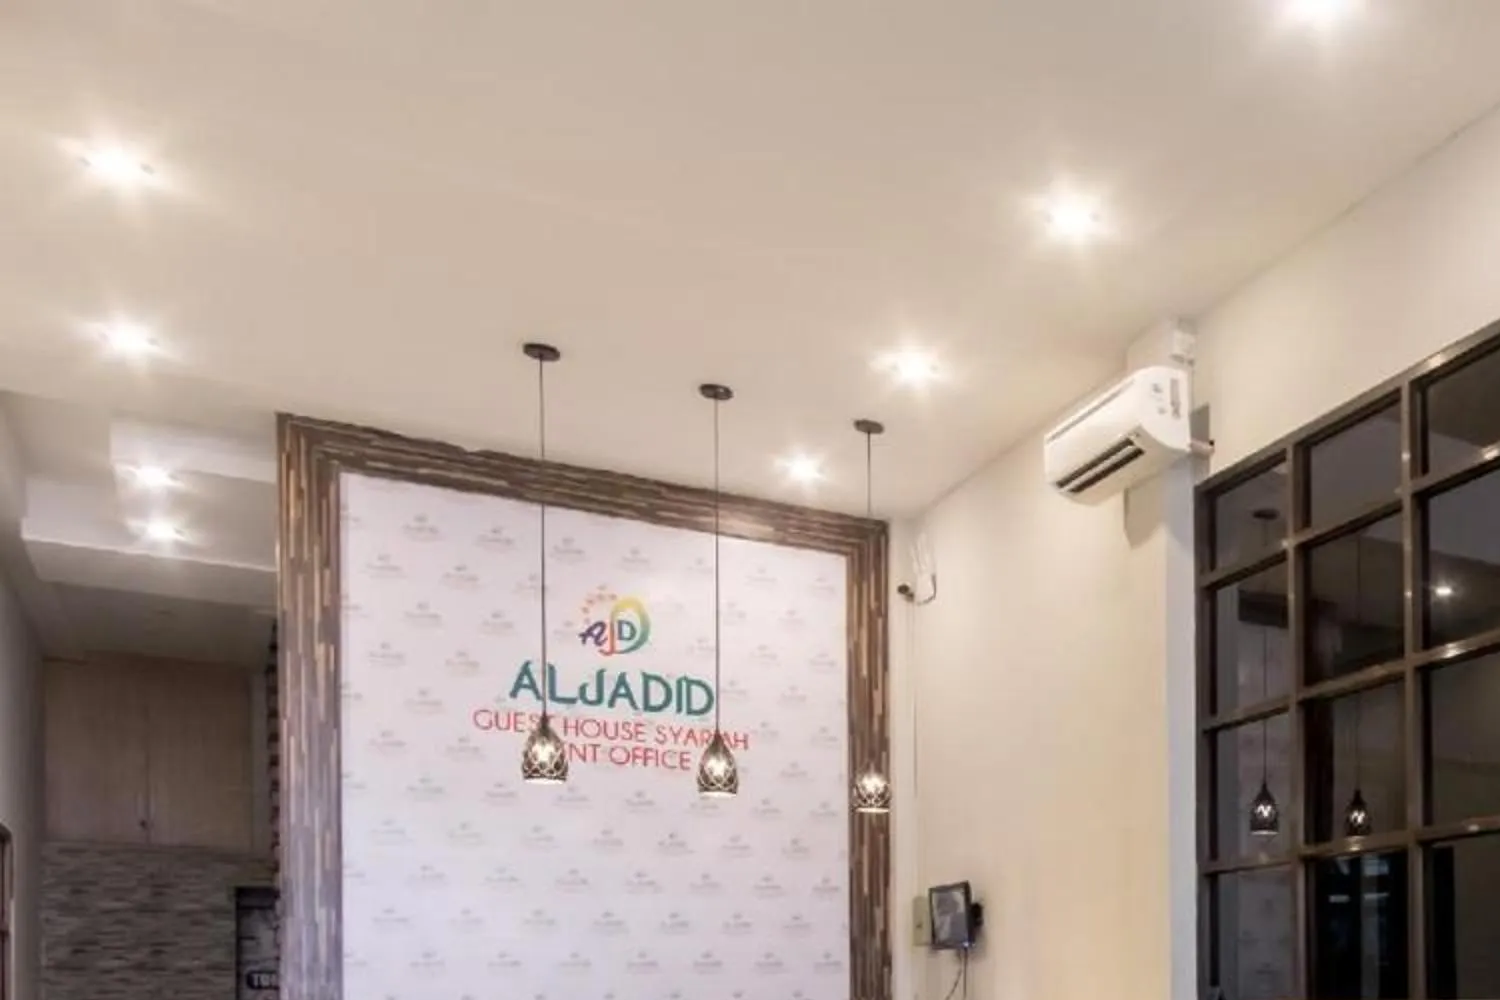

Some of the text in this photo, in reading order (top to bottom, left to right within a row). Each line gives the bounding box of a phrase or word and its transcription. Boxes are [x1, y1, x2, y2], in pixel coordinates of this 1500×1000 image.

[509, 660, 714, 715] ALJADID
[563, 717, 647, 742] HOUSE
[655, 724, 749, 750] SYARAH
[609, 746, 691, 770] OFFICE
